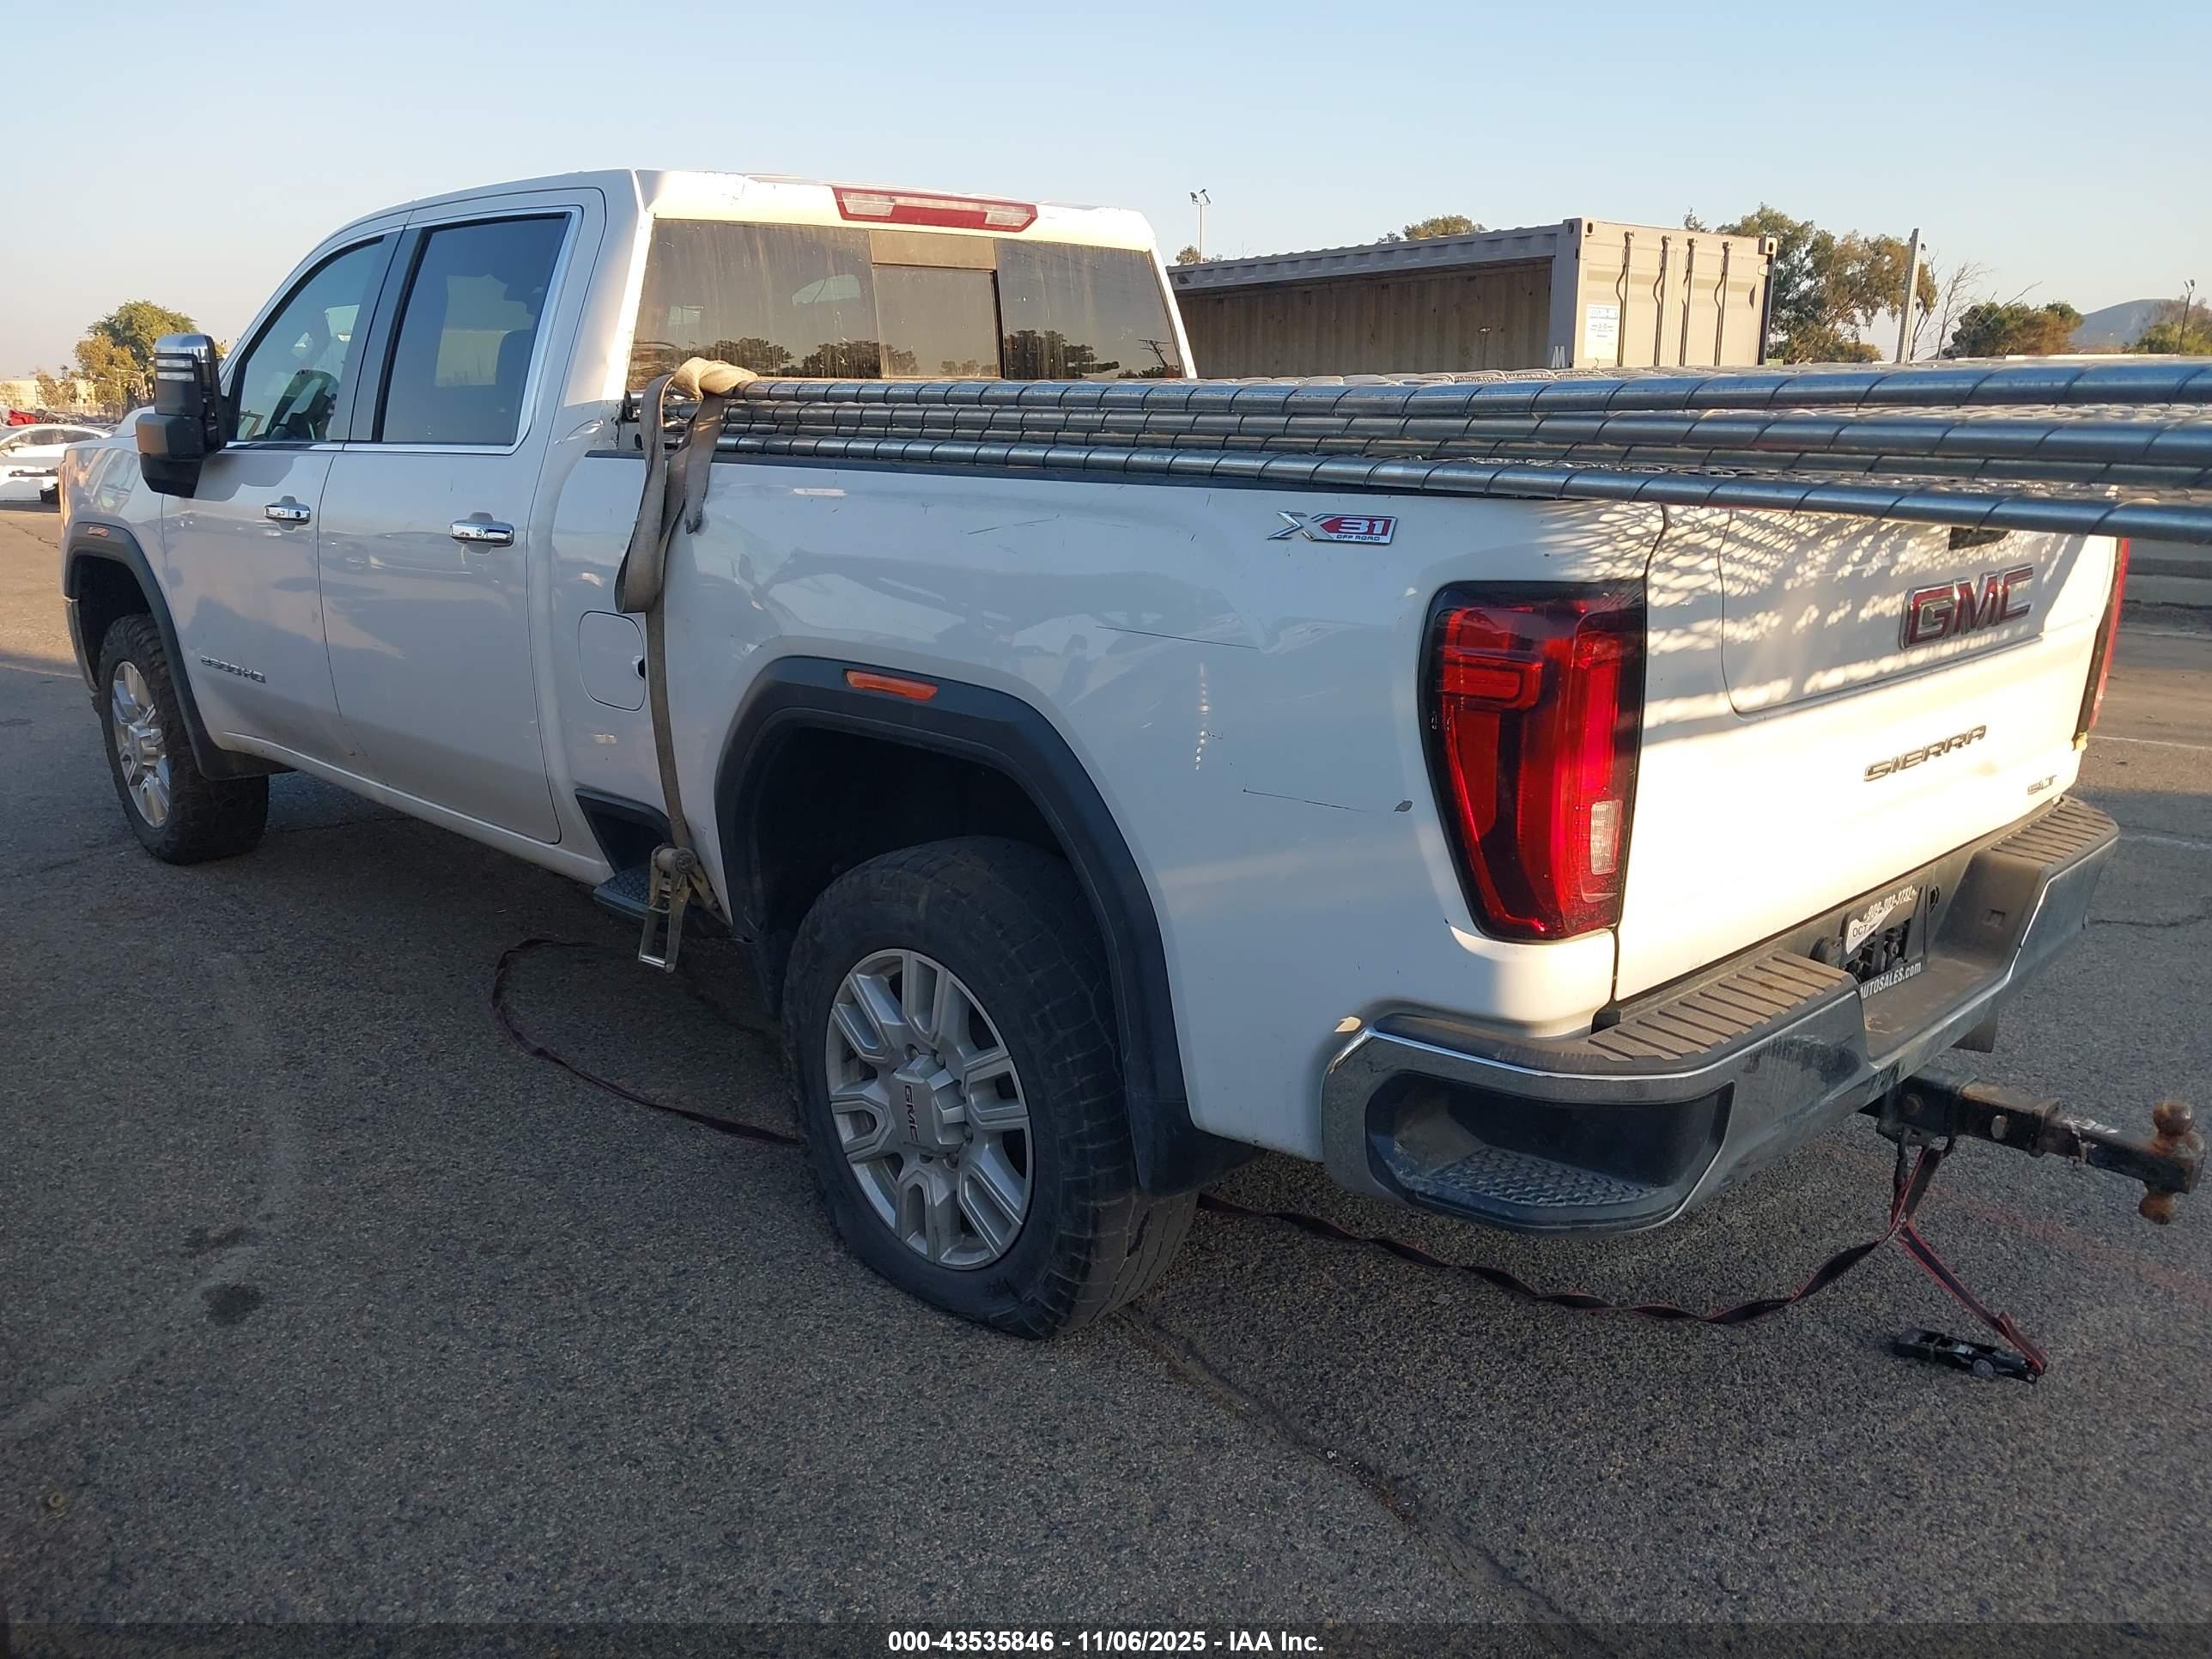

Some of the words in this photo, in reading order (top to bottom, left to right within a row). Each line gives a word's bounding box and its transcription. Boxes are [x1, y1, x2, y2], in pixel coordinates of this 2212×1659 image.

[1899, 562, 2034, 650] GMC
[1864, 725, 1987, 782] SIERRA
[2027, 775, 2057, 795] SLT
[1852, 924, 1868, 938] OCT
[904, 1085, 920, 1141] GMC
